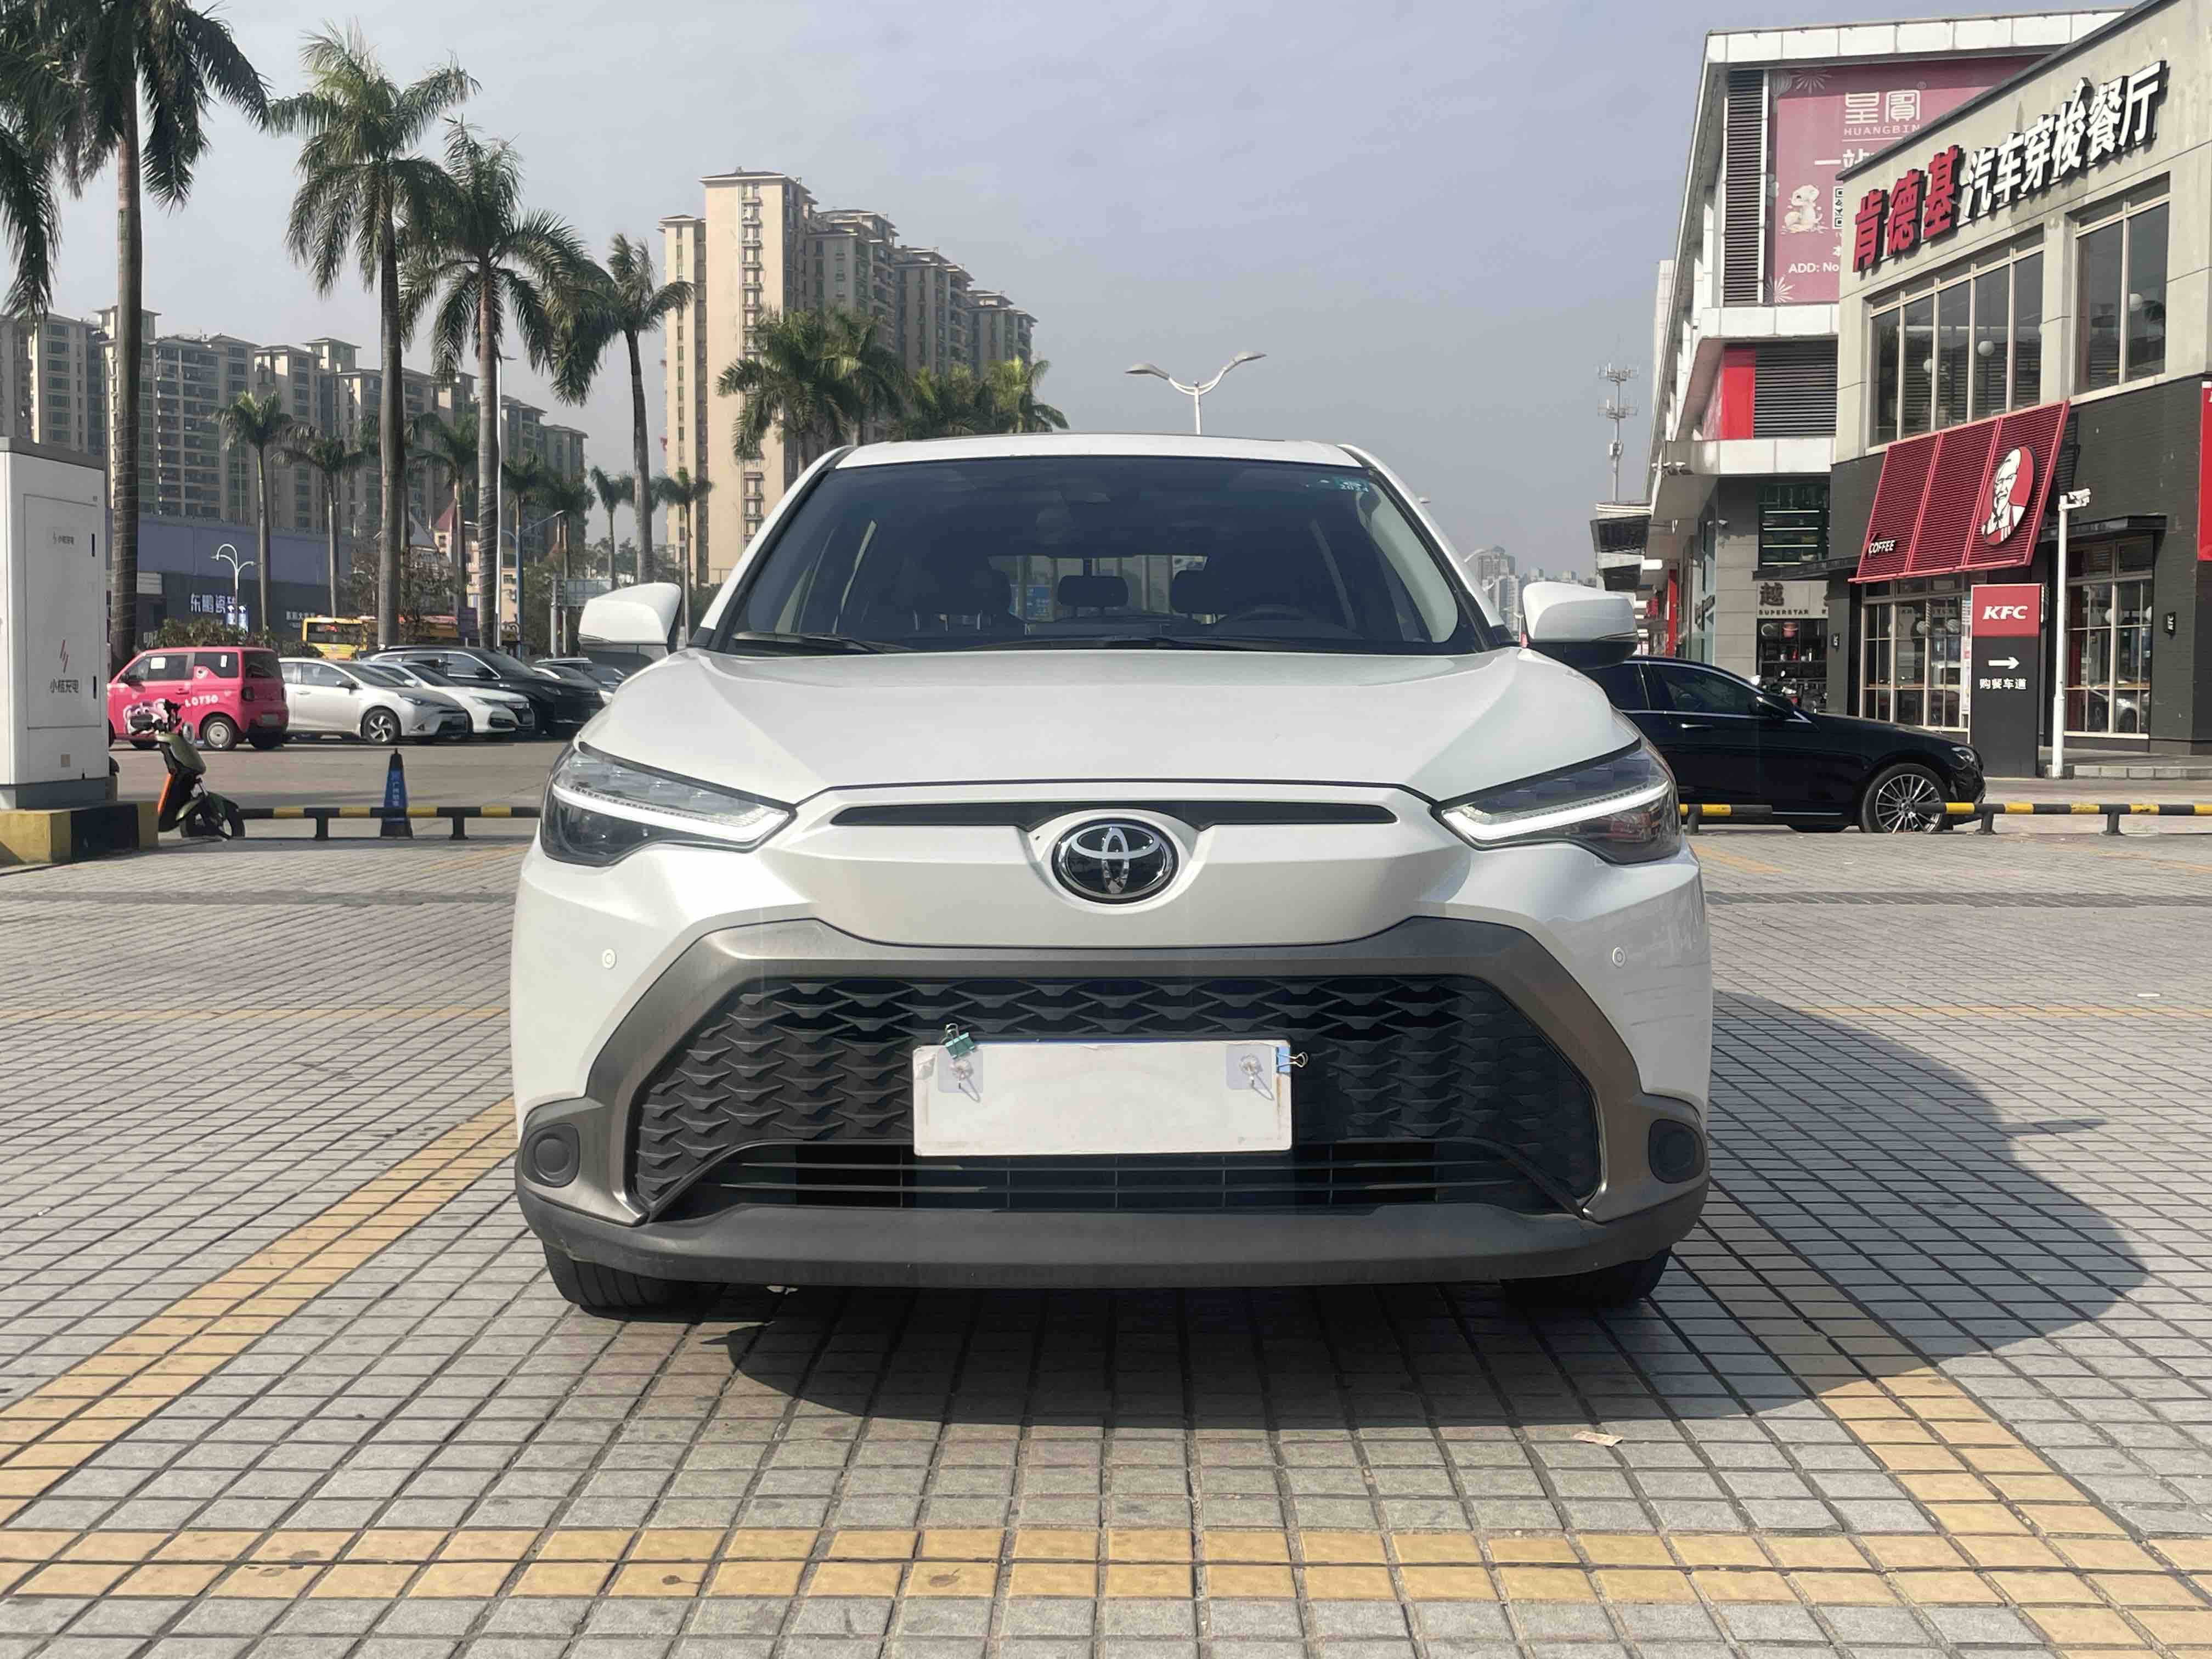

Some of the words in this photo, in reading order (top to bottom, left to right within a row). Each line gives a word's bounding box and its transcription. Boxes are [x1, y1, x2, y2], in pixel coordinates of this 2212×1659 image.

[1843, 124, 1920, 136] HUANGBIN
[1853, 61, 2165, 273] 肯德基汽车穿梭餐厅
[1788, 263, 1820, 273] ADD:
[1868, 540, 1895, 554] COFFEE
[1982, 605, 2028, 620] KFC
[1979, 678, 2027, 690] 购餐车道
